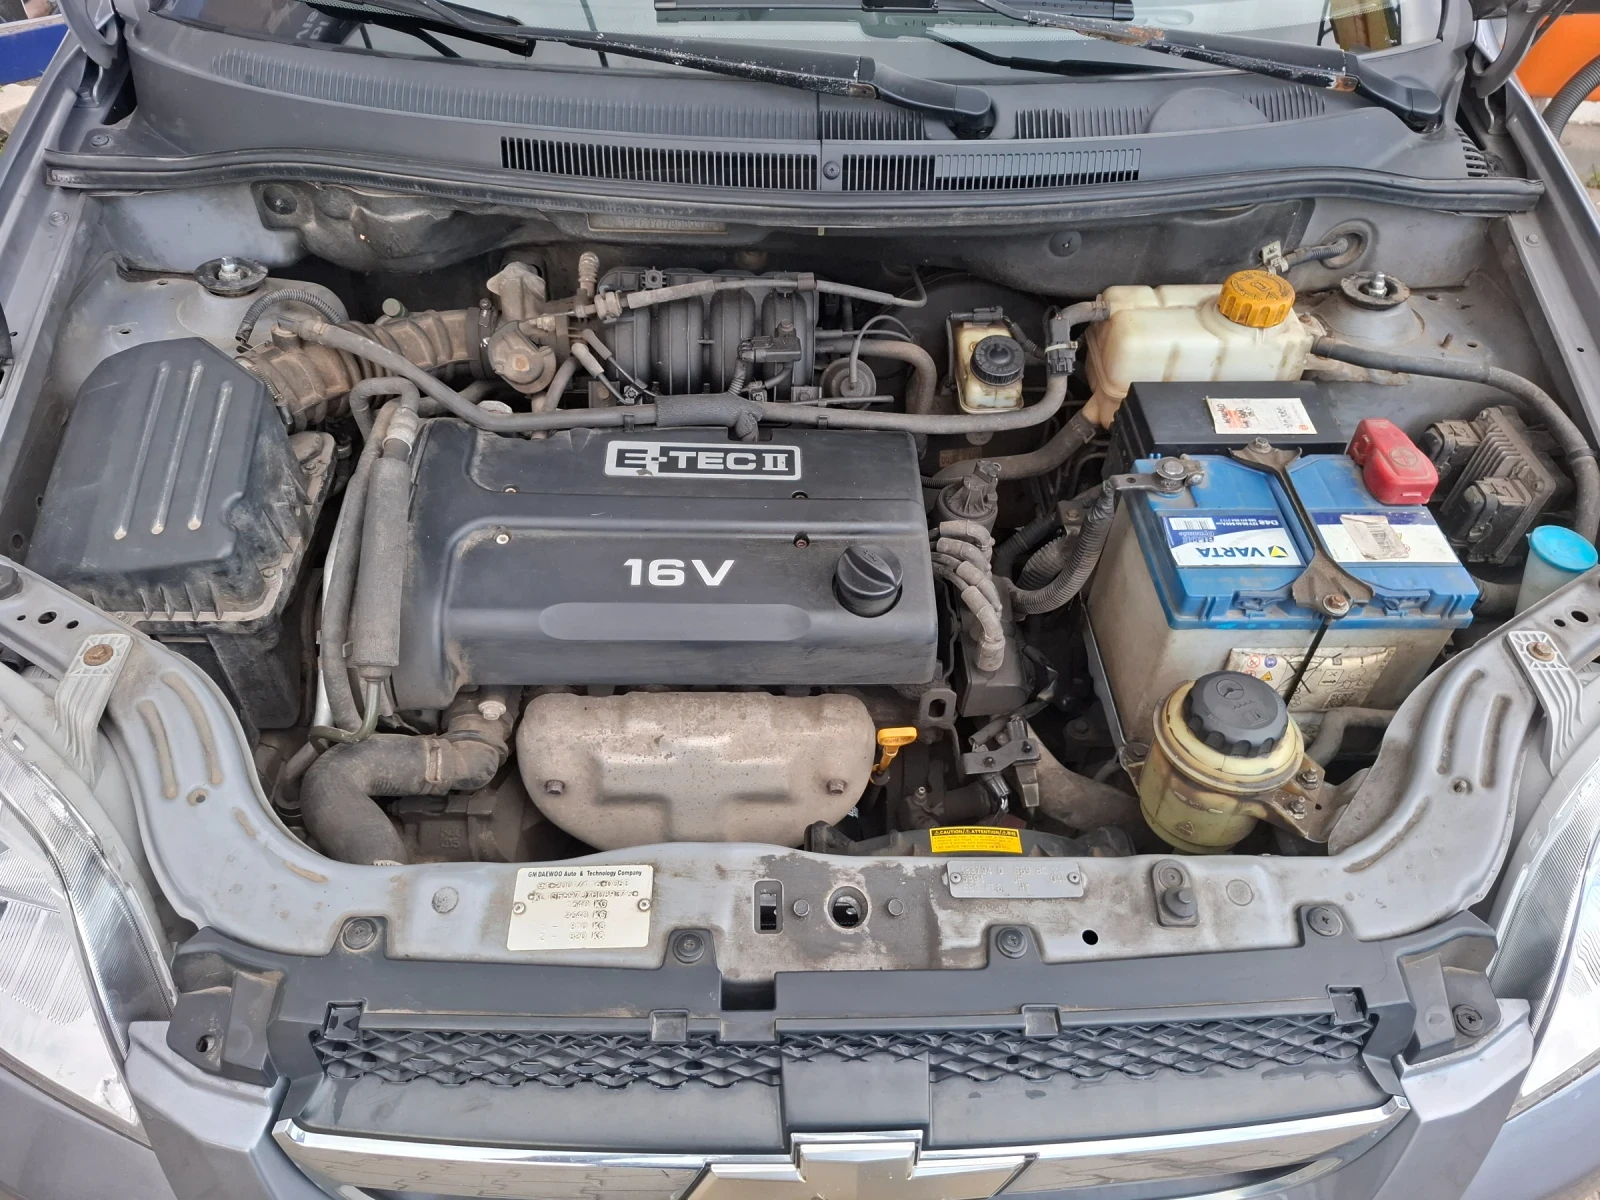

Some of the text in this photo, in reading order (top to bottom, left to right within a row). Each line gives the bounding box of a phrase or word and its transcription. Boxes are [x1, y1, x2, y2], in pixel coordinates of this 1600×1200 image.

[616, 449, 757, 470] E-TEC
[1195, 547, 1265, 558] VARTA
[593, 900, 608, 908] KG
[592, 910, 608, 919] KG
